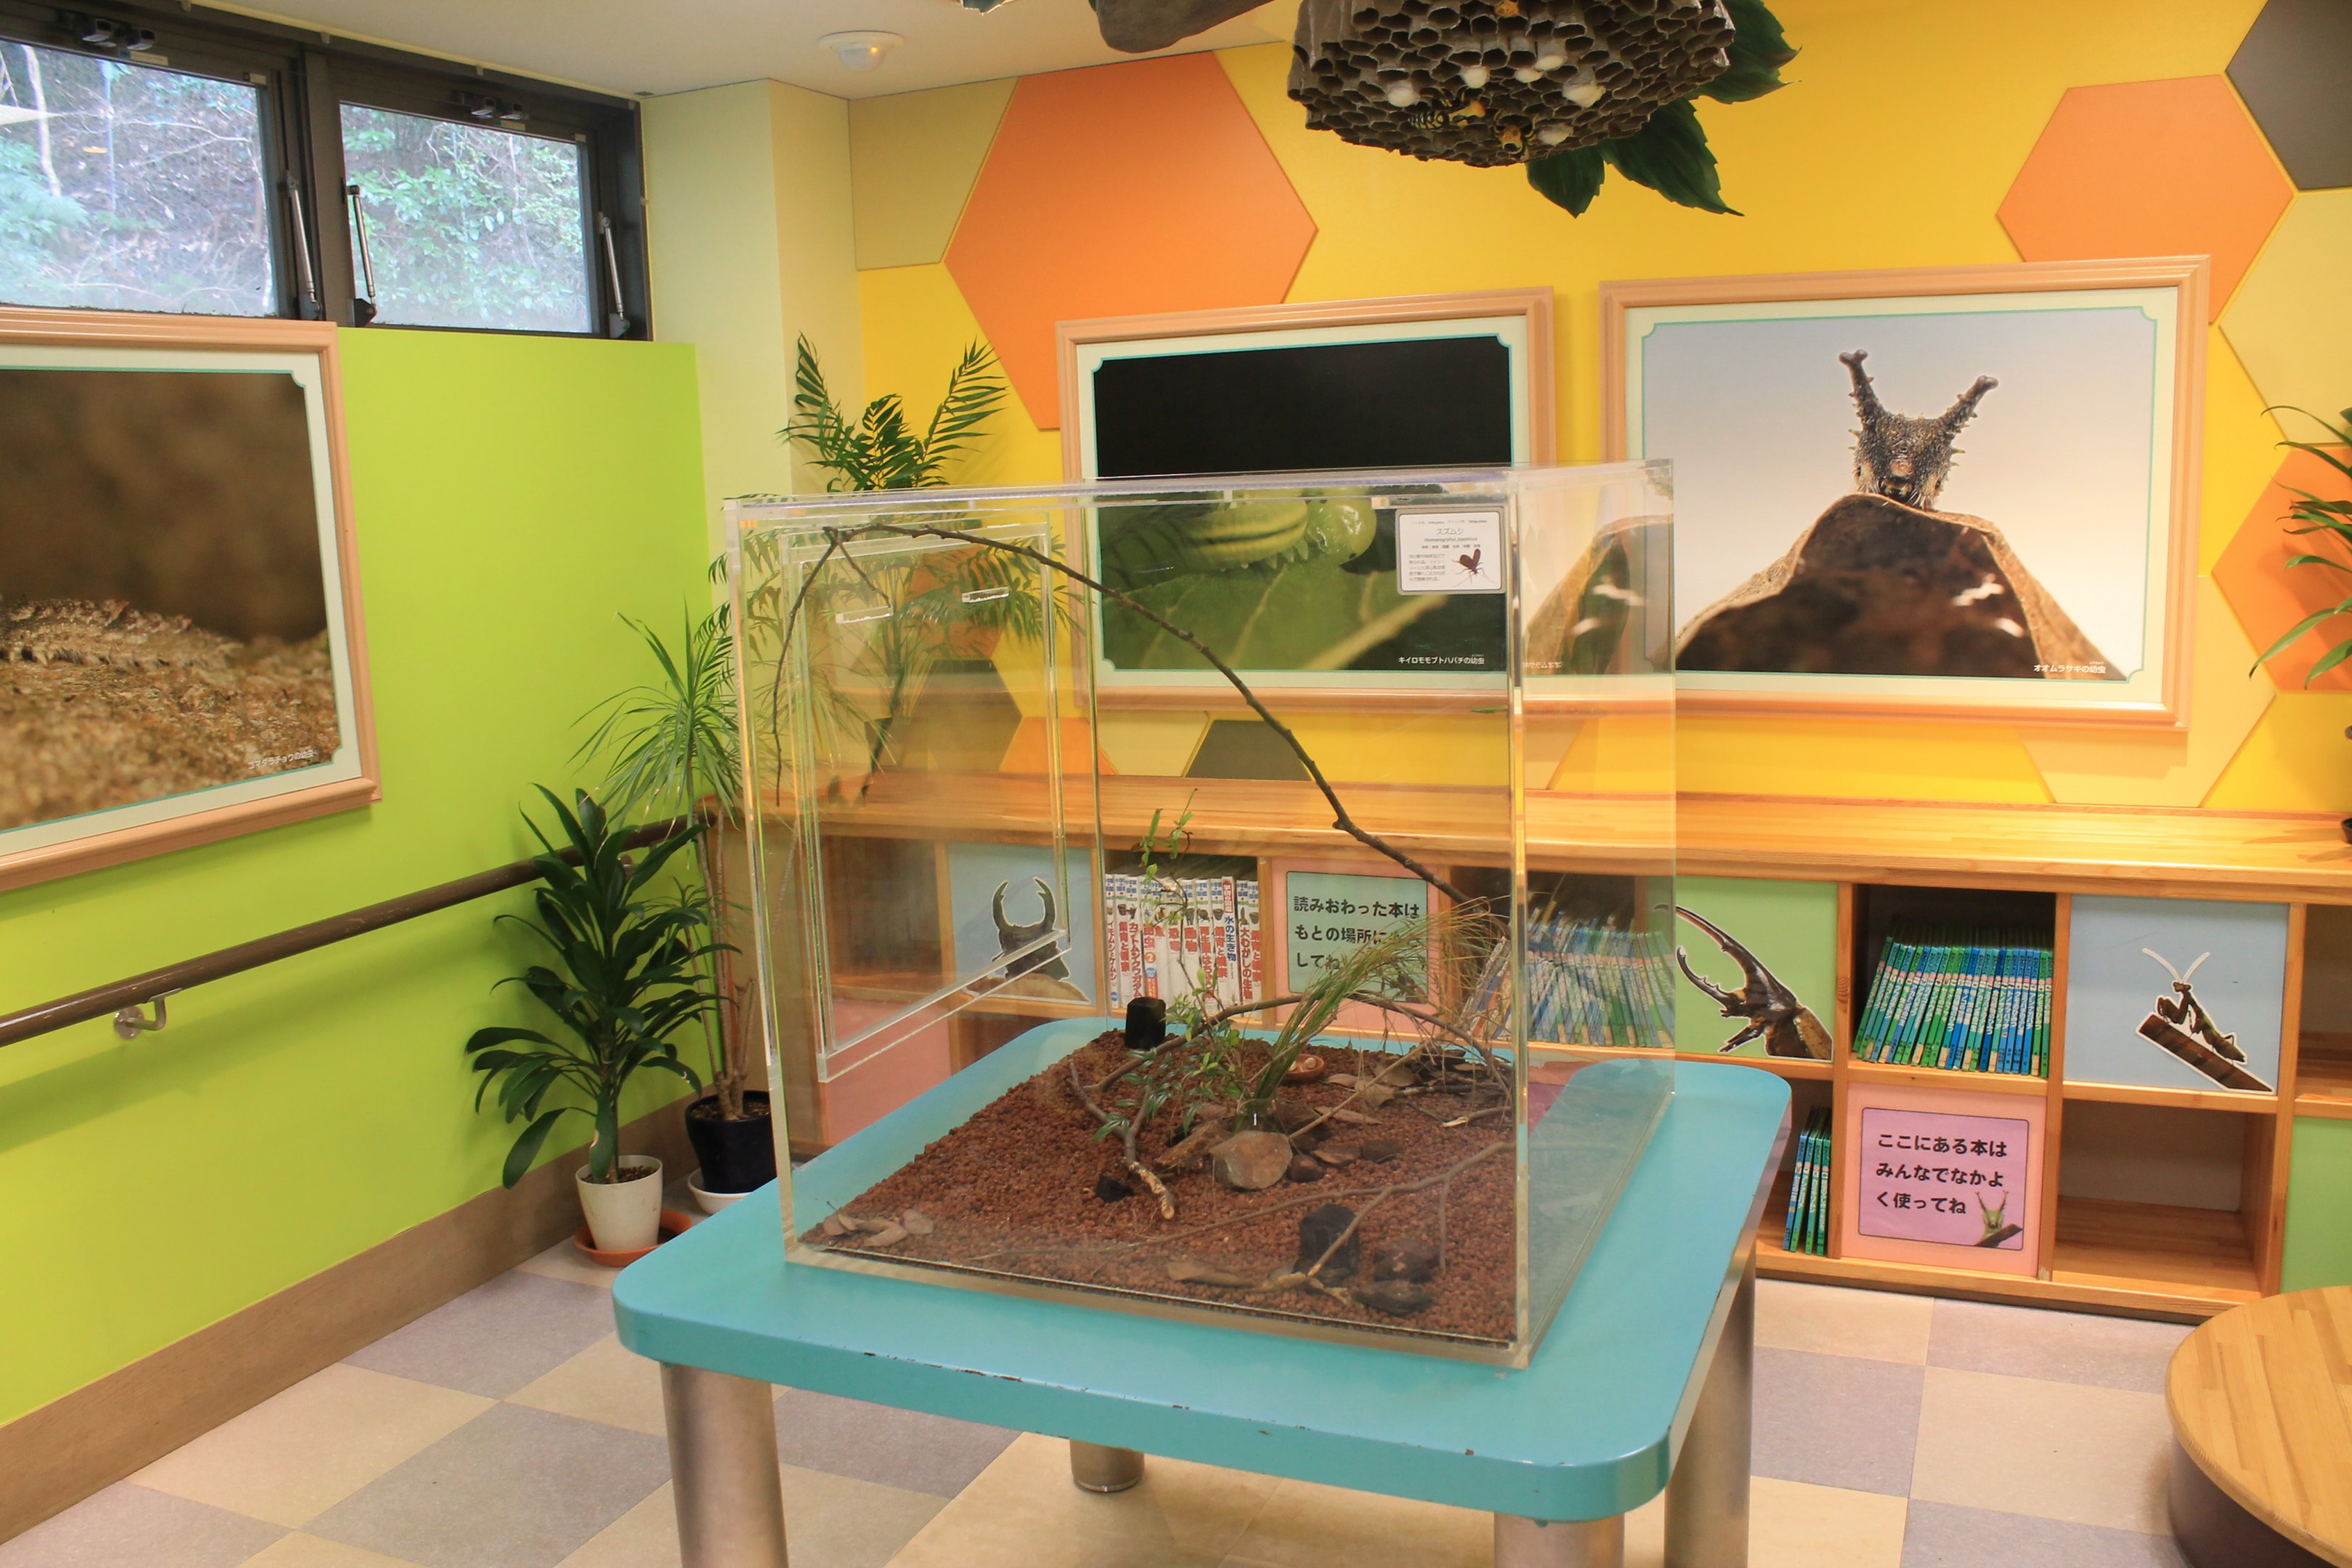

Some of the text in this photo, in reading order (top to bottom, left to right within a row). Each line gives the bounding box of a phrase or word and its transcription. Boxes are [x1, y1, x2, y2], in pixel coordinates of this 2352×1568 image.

[1398, 656, 1485, 665] キイロモモブトハバチの幼虫
[2033, 663, 2106, 674] オオムラサキの幼虫
[1294, 896, 1420, 919] 読みおわった本は
[1225, 916, 1236, 962] 水の生き物
[1294, 924, 1400, 945] もとの場所に
[1108, 920, 1116, 981] イモムシとケムシ
[1878, 1134, 2007, 1158] ここにある本は
[1876, 1162, 2004, 1187] みんなでなかよ
[1877, 1191, 1967, 1214] く使ってね
